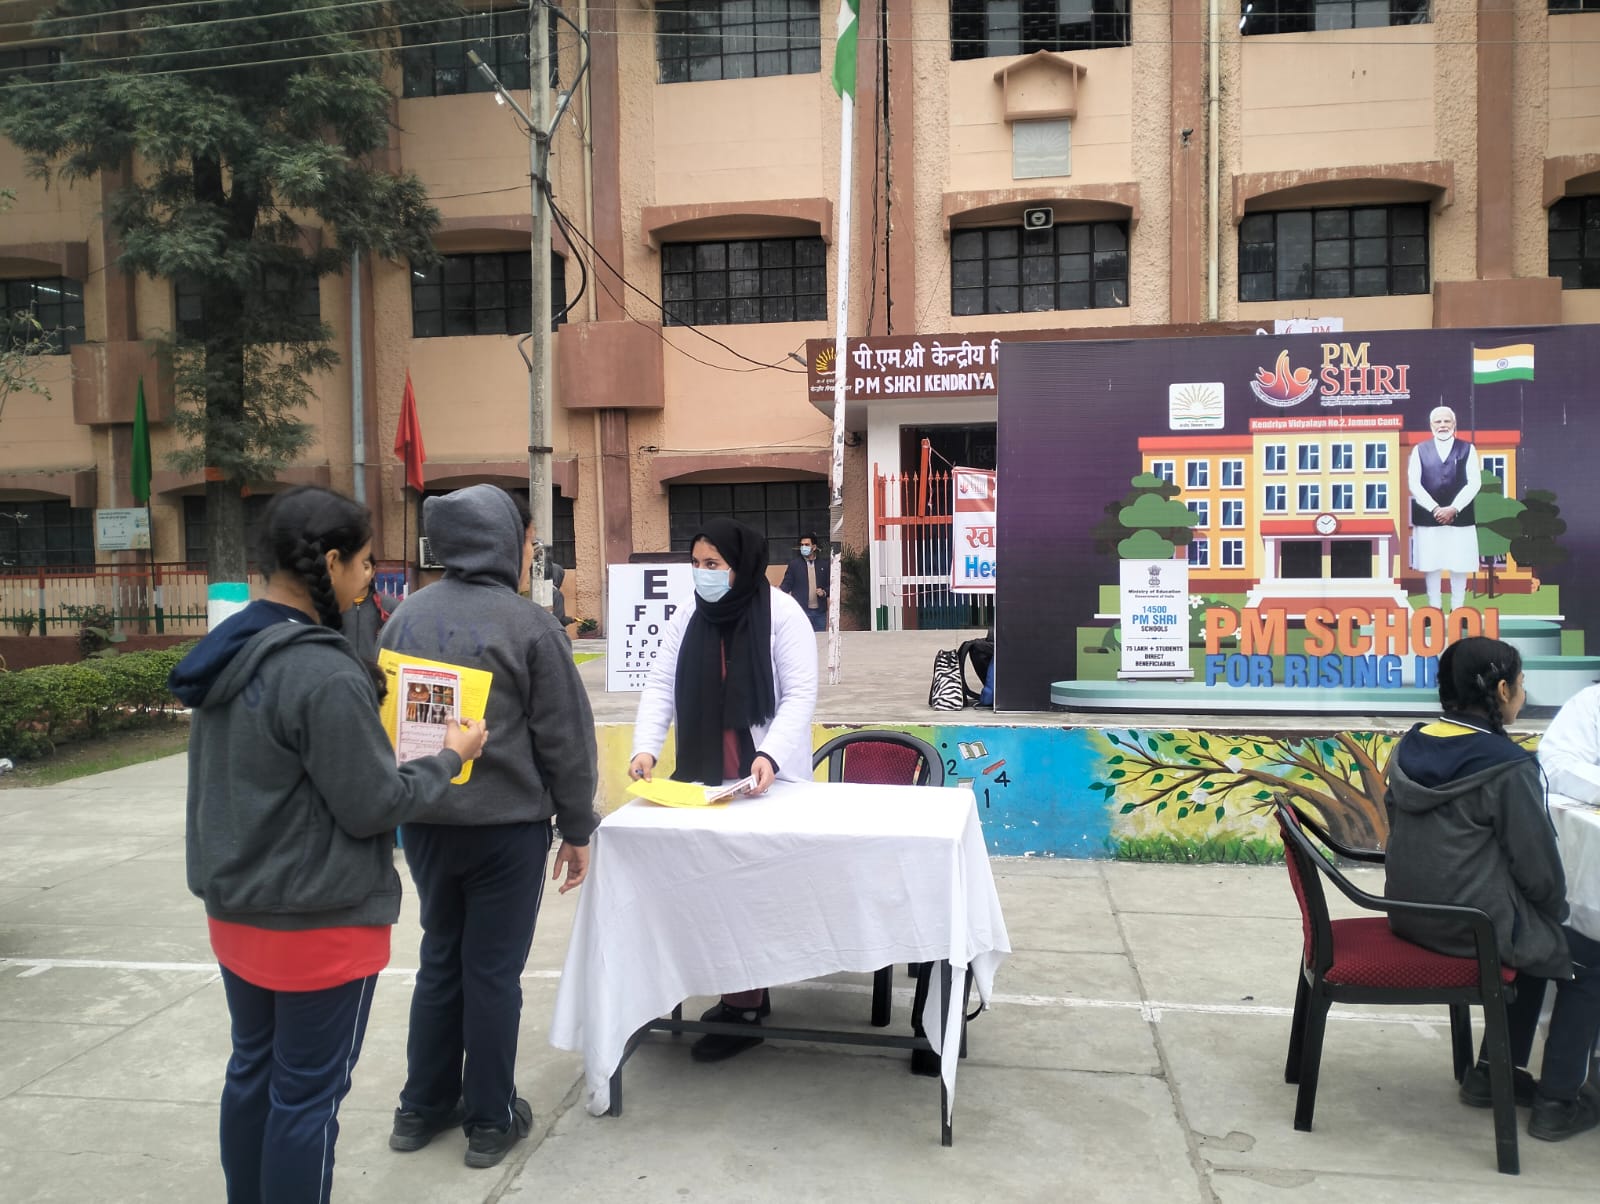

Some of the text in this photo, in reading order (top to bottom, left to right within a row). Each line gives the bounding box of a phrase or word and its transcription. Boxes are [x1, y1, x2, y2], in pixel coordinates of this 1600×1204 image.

[852, 342, 926, 372] पी.एम.श्री
[931, 340, 986, 370] केन्द्रीय
[1320, 342, 1370, 368] PM
[854, 372, 995, 394] PM SHRI KENDRIYA
[1320, 365, 1410, 396] SHRI
[644, 570, 668, 599] E
[635, 604, 677, 621] F P
[1132, 614, 1177, 624] PM SHRI
[626, 624, 658, 635] T O
[1206, 607, 1287, 656] PM
[1206, 653, 1274, 688] FOR
[1284, 653, 1402, 688] RISING
[946, 759, 958, 776] 2
[994, 770, 1011, 788] 4
[984, 788, 990, 808] 1
